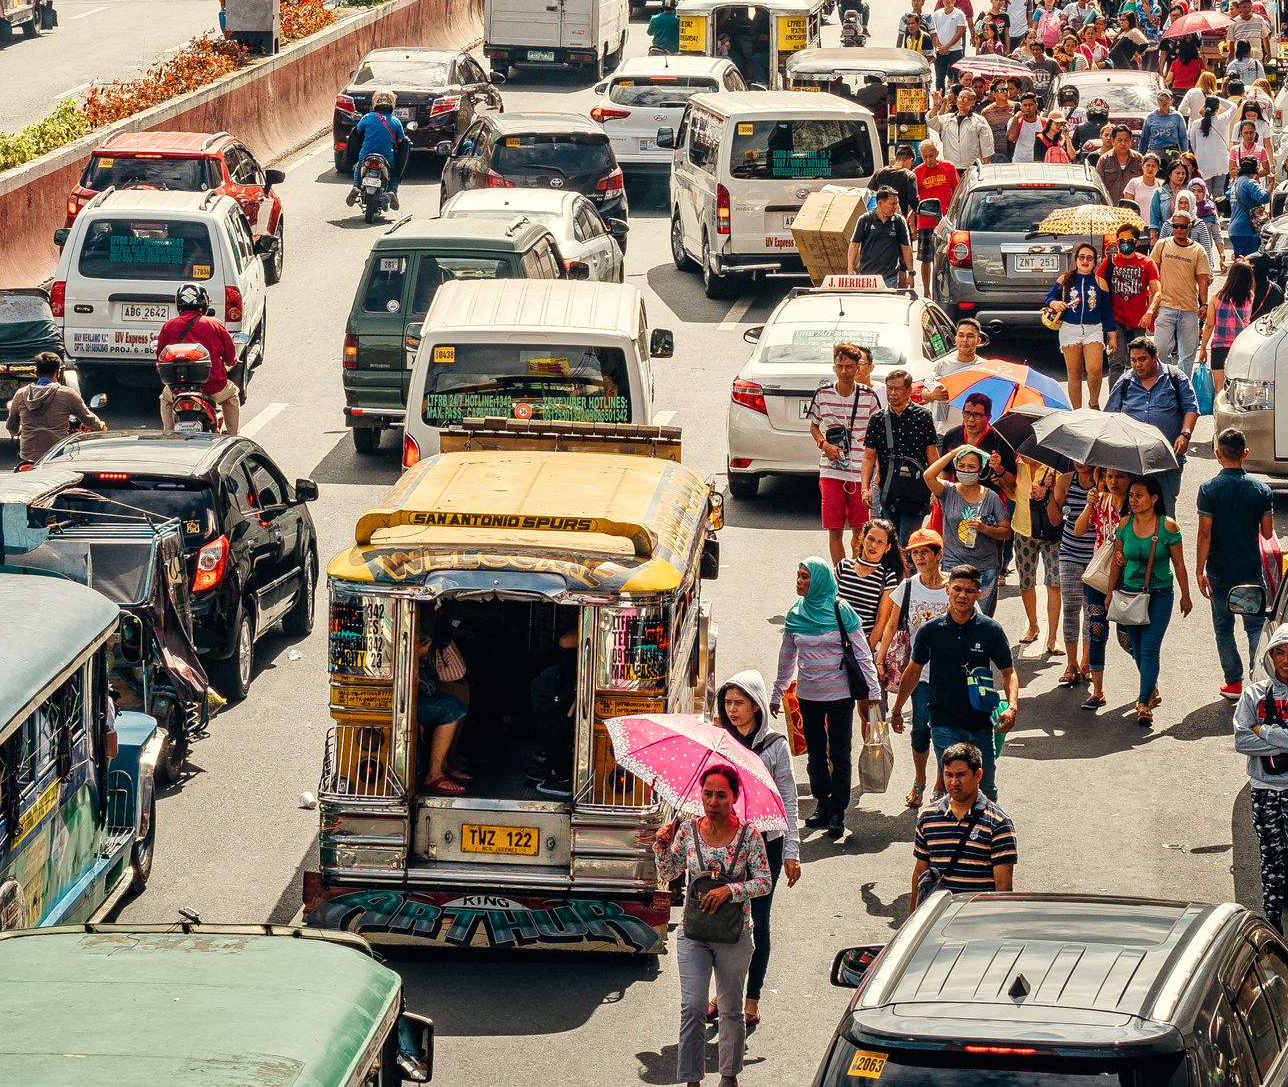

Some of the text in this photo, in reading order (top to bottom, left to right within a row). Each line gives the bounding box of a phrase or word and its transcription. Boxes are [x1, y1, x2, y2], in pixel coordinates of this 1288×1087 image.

[765, 236, 794, 250] UV Express
[1020, 259, 1055, 267] ZNT 251
[828, 277, 878, 288] J. HERRERA
[124, 308, 168, 318] ABG 2642
[114, 331, 149, 347] UV Express
[413, 513, 594, 532] SAN ANTONIO SPURS
[467, 829, 533, 849] TWZ 122
[463, 895, 510, 909] KING
[323, 890, 638, 945] ARTHUR
